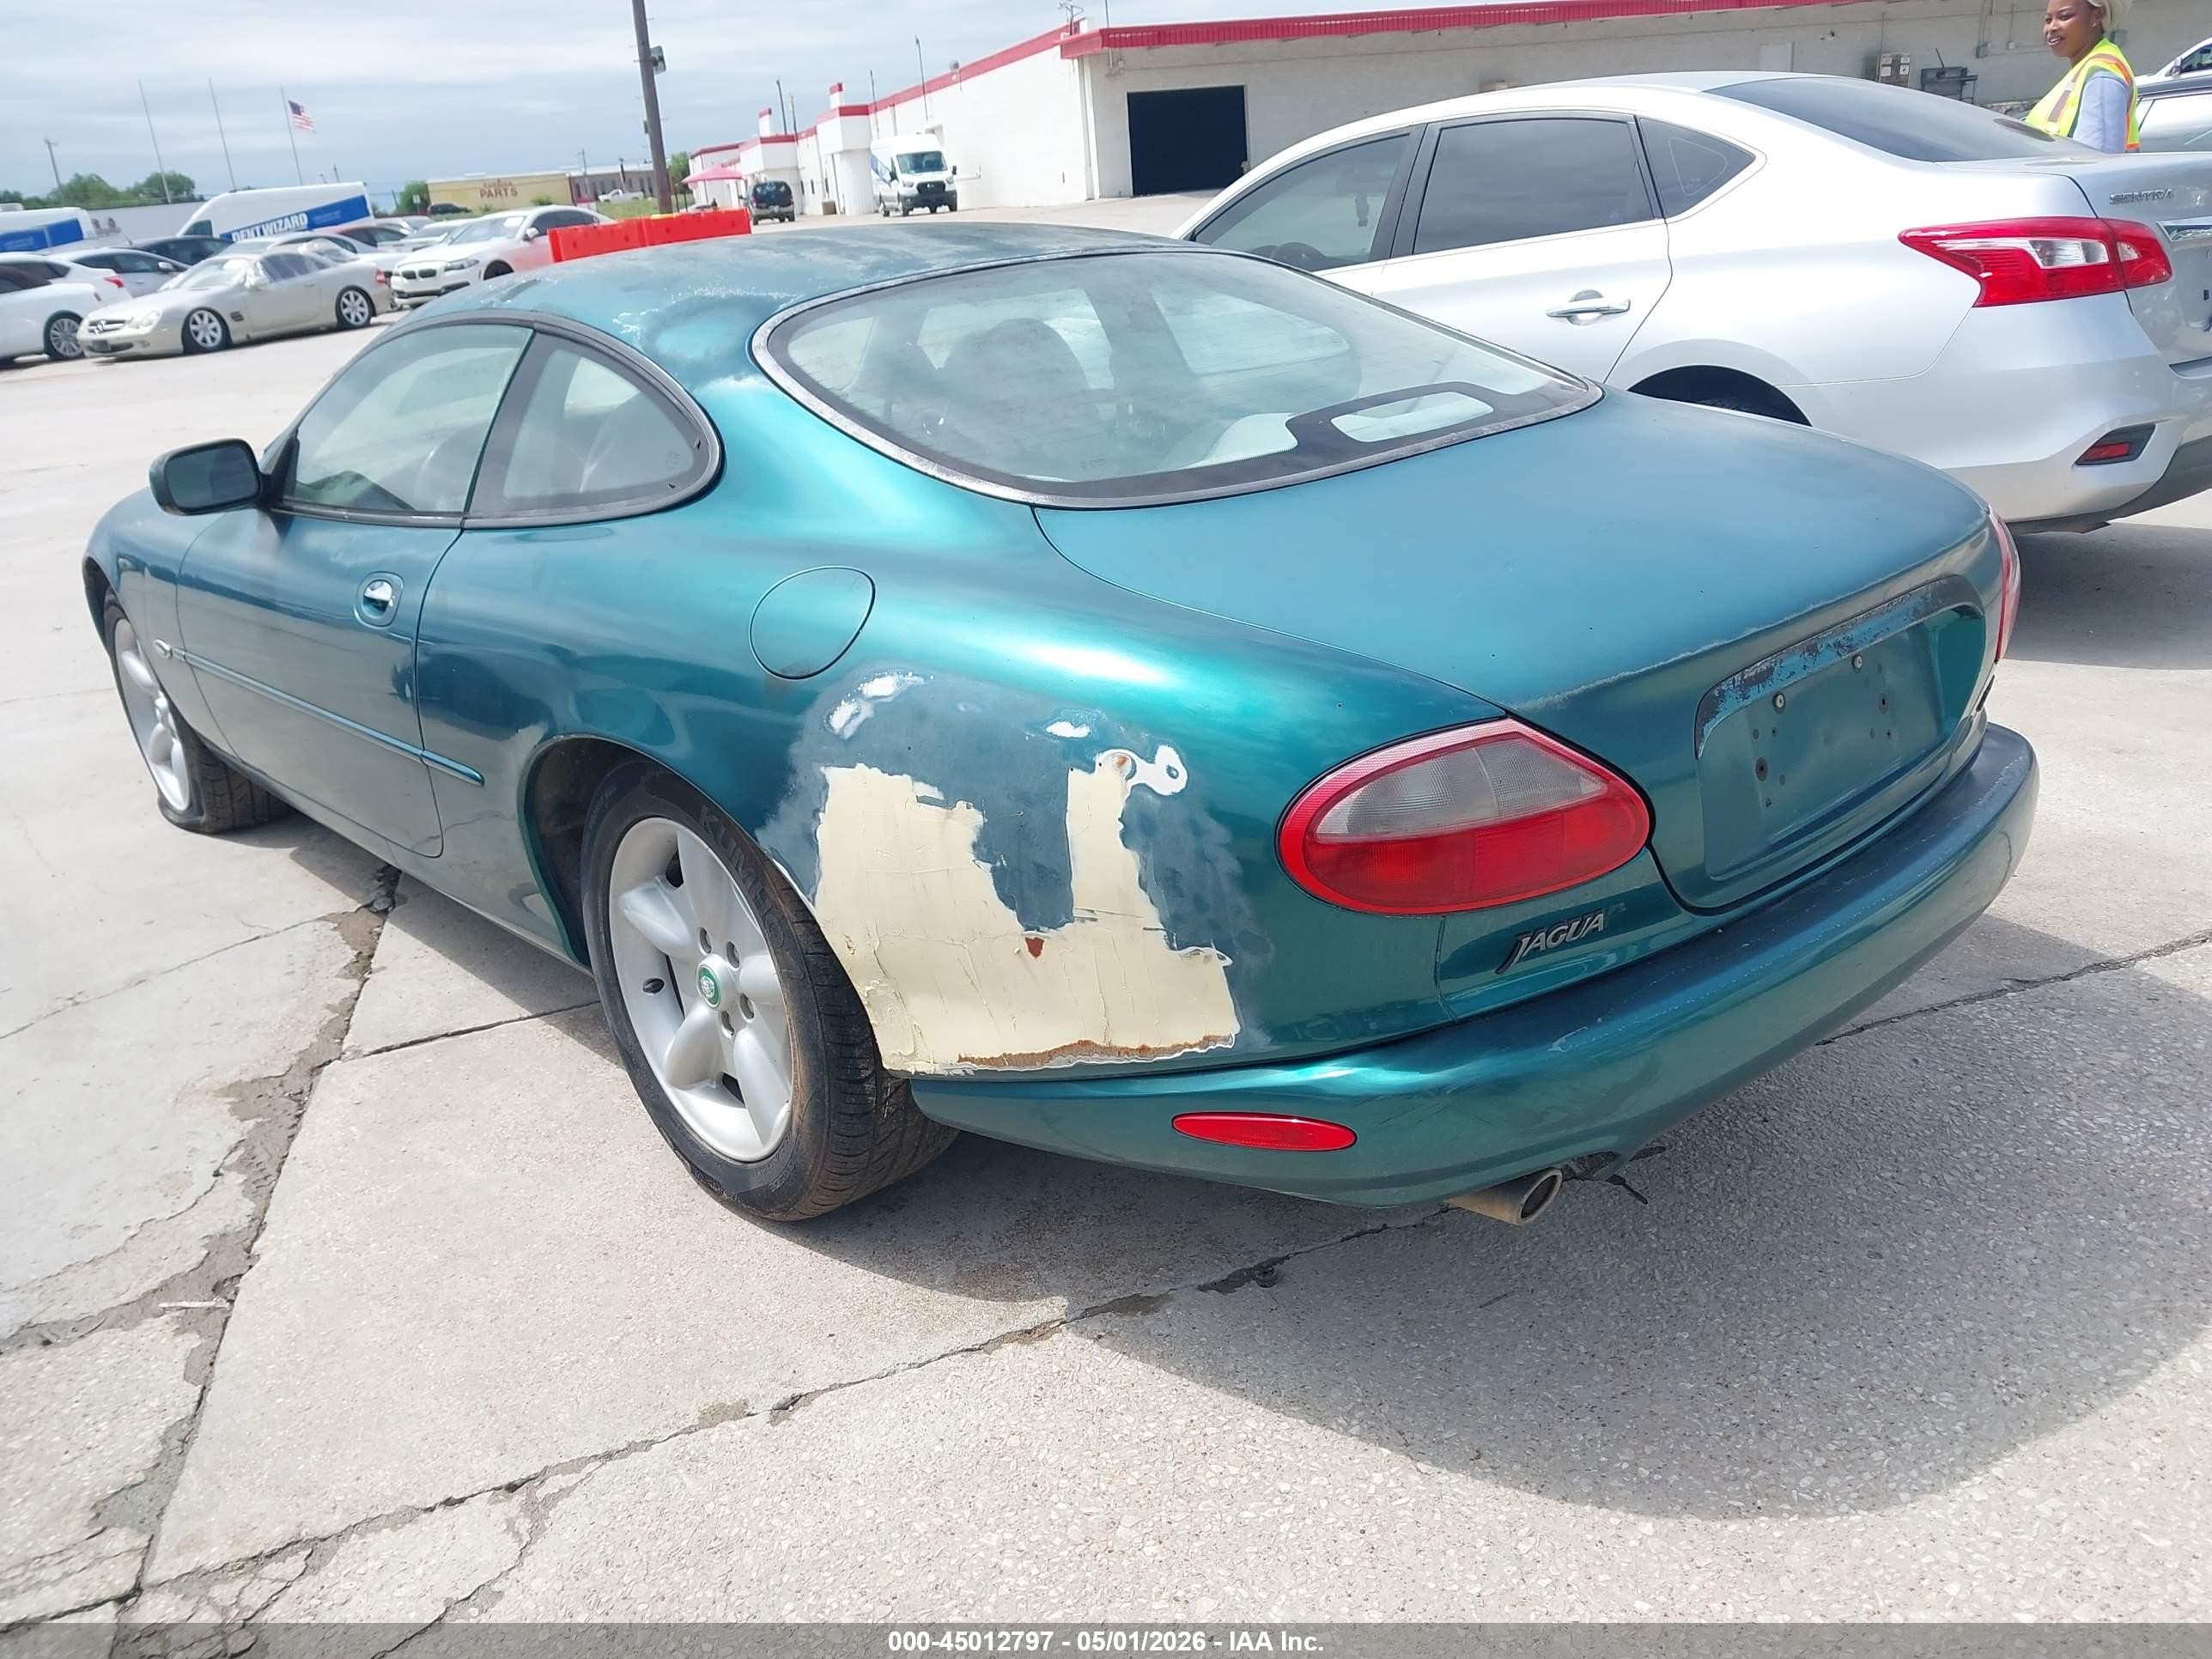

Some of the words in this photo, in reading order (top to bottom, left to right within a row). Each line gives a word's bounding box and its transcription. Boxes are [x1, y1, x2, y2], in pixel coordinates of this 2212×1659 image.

[480, 185, 519, 198] PARTS
[2109, 187, 2173, 204] SENTRA
[261, 212, 309, 236] WIZARD
